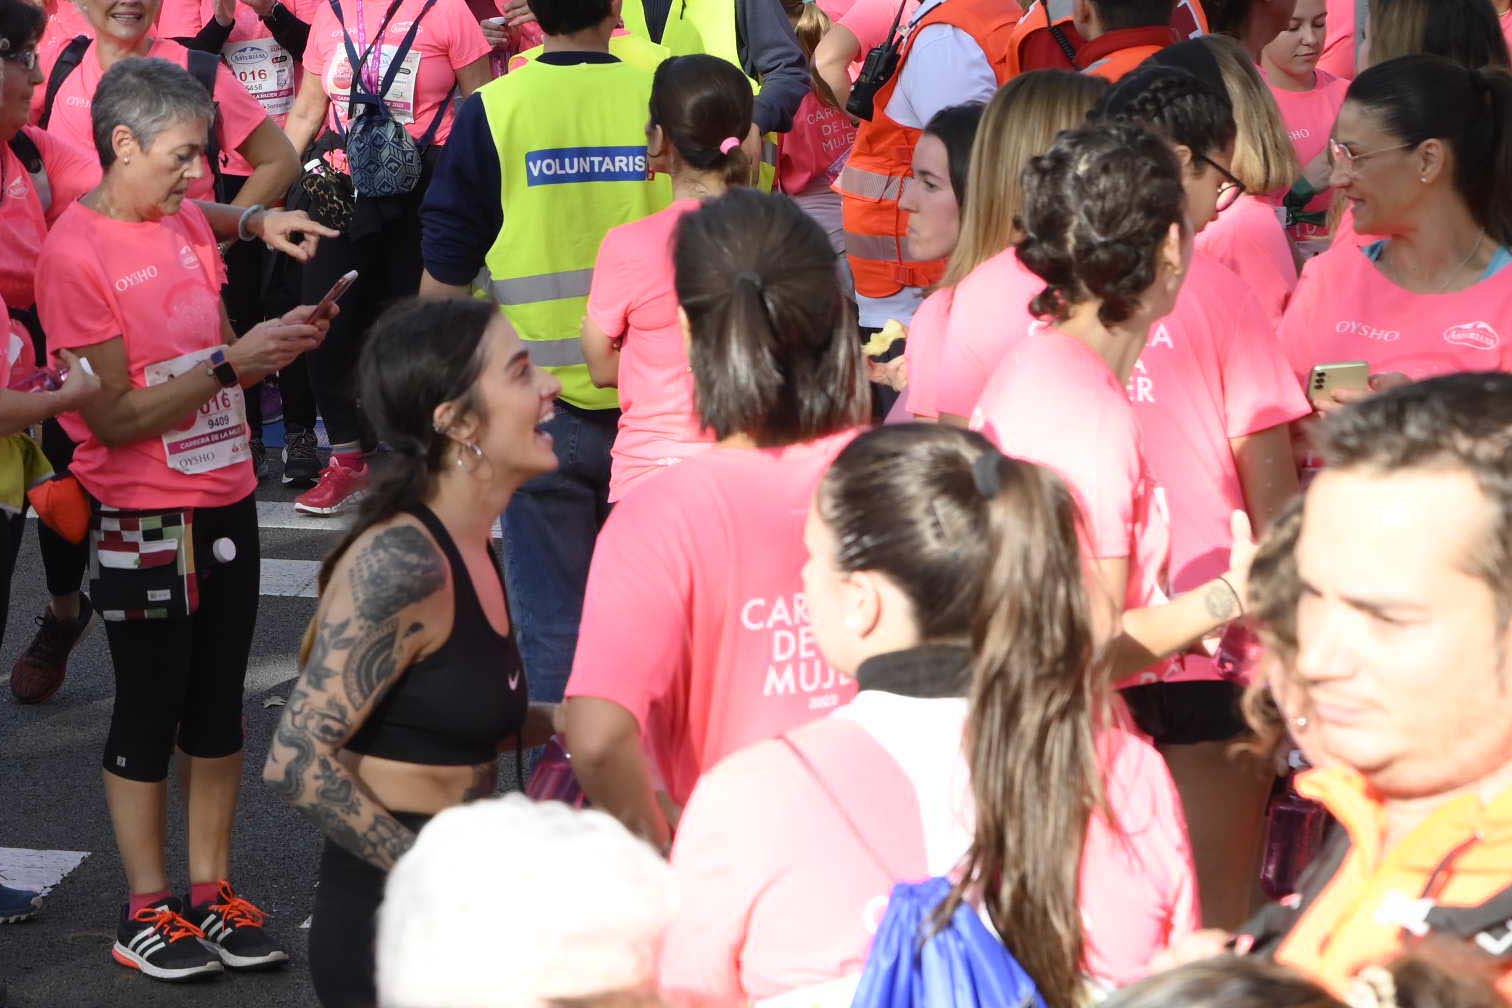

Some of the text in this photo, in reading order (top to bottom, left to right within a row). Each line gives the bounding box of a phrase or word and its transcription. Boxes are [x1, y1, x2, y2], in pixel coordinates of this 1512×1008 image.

[239, 69, 268, 82] 016
[822, 121, 840, 136] DE
[822, 132, 856, 153] MUJE
[529, 155, 647, 178] VOLUNTARIS
[1336, 319, 1400, 342] OYSHO
[207, 415, 230, 429] 9409
[179, 451, 216, 467] OYSHO
[741, 595, 809, 630] CAR
[774, 626, 816, 662] DE
